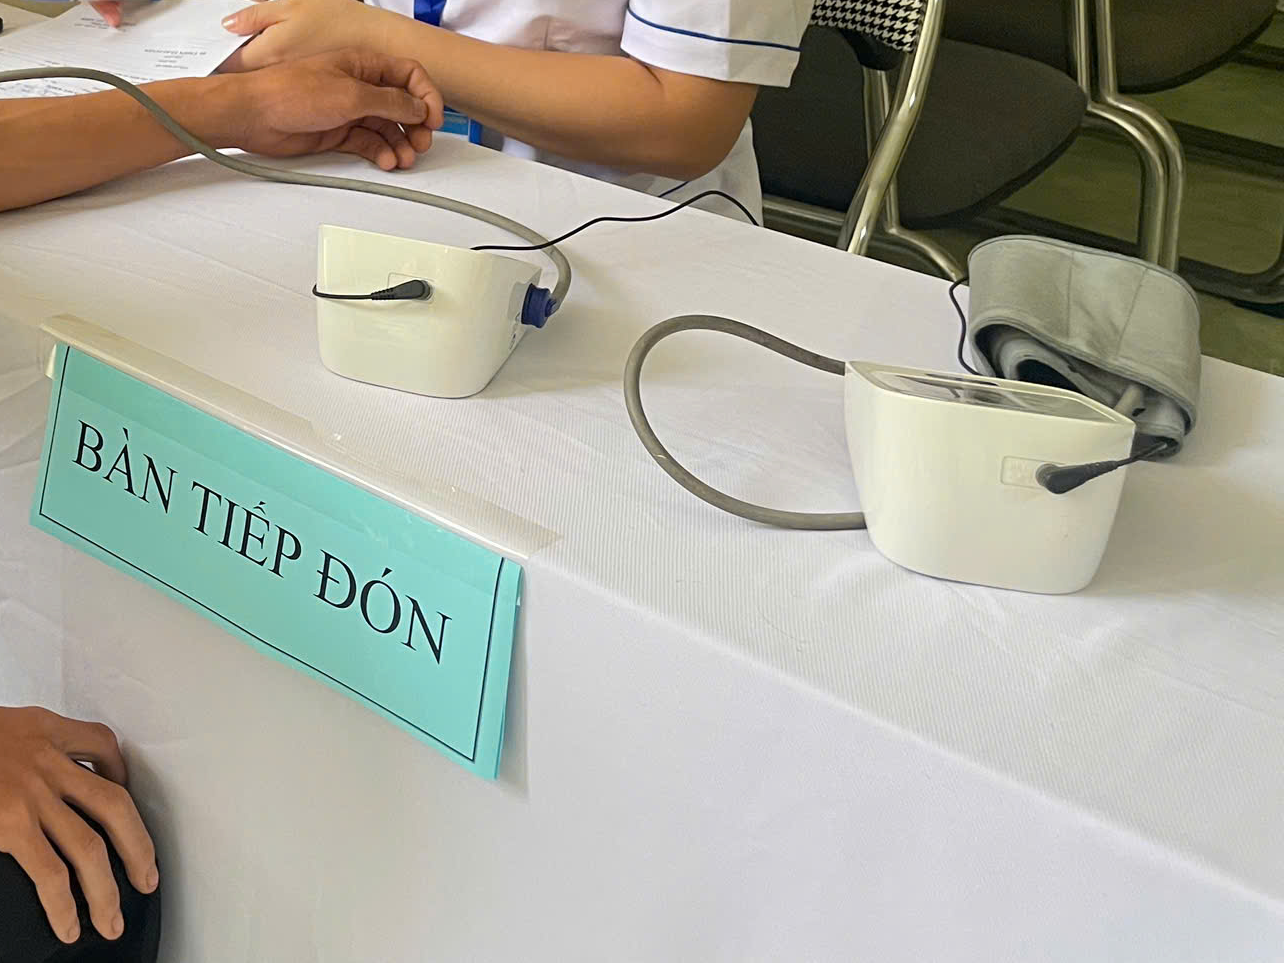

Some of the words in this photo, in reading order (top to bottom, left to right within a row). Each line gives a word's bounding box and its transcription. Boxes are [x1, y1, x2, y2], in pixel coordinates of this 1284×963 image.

[72, 419, 178, 515] BÀN
[190, 481, 303, 579] TIẾP
[313, 548, 452, 665] ĐÓN
